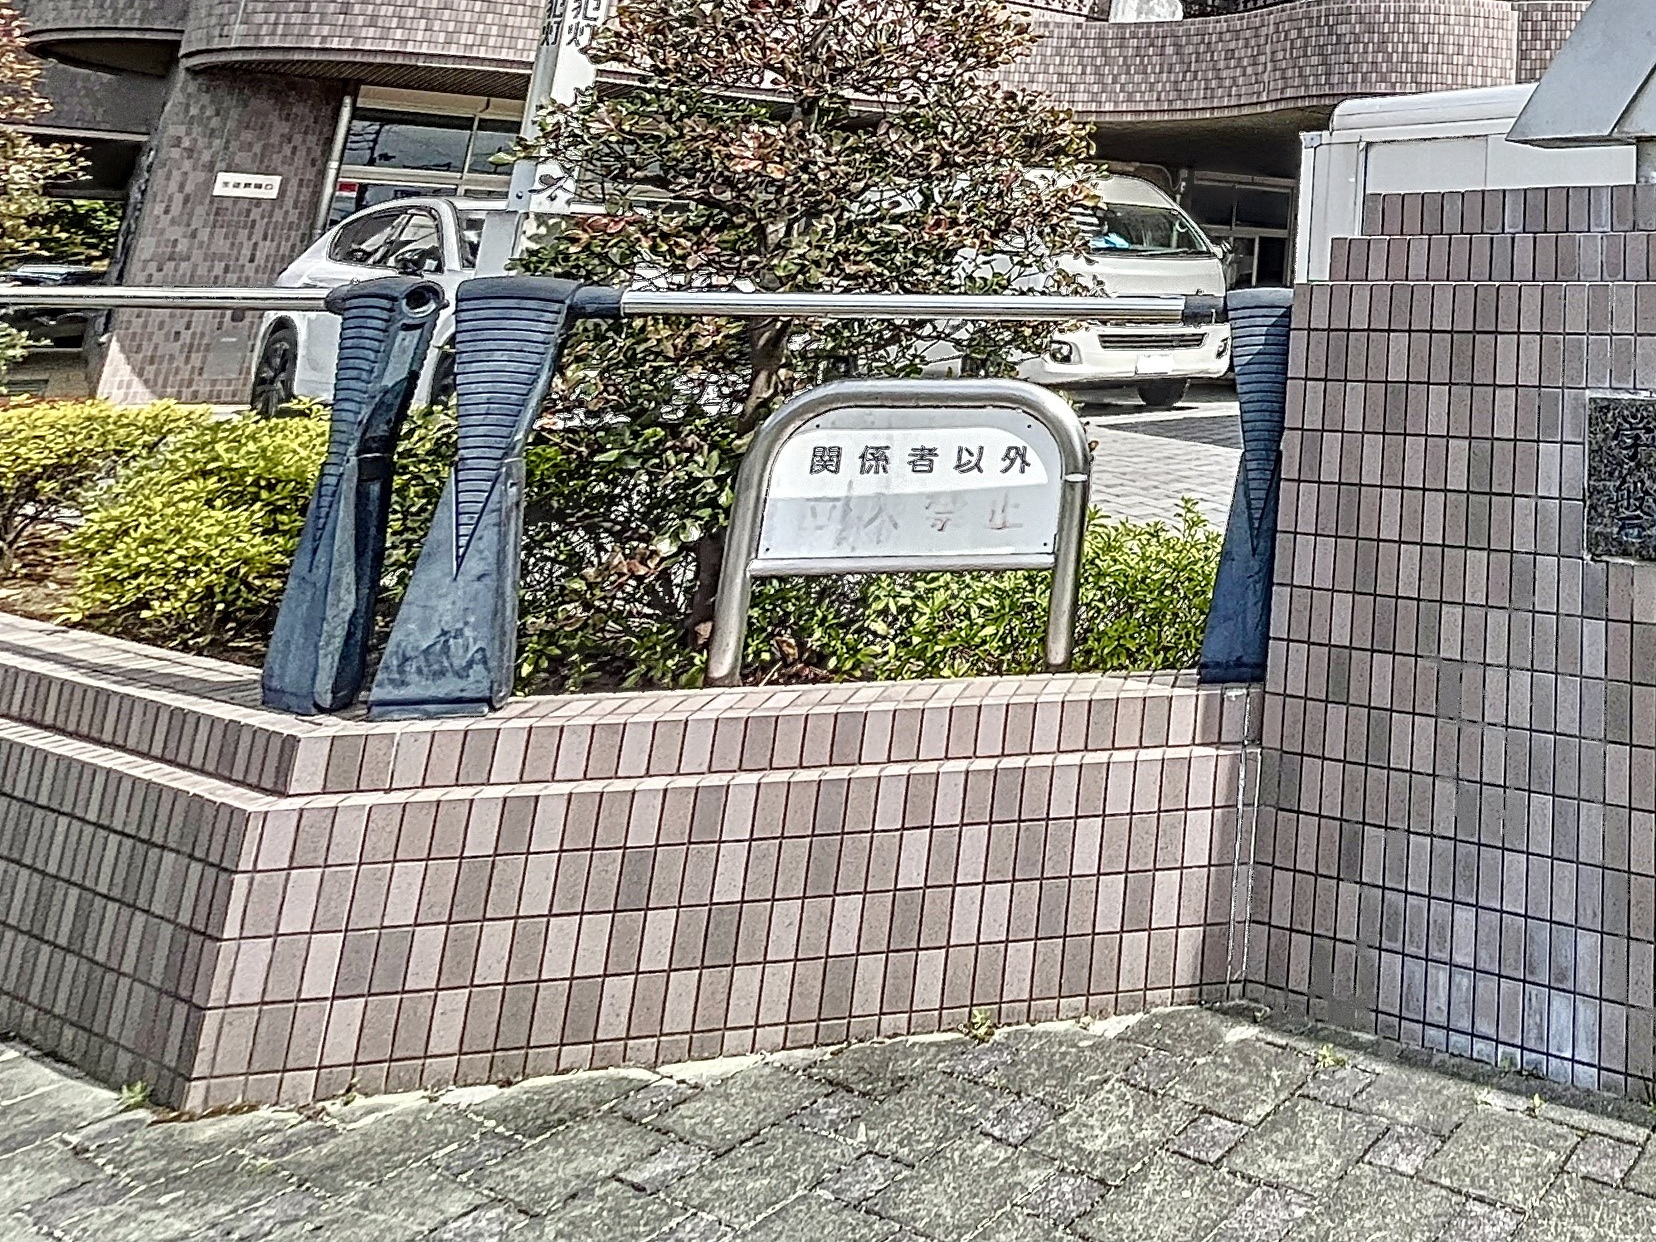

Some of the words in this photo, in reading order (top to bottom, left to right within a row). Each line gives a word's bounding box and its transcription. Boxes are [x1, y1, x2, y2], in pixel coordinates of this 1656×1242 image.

[808, 445, 1032, 476] 関係者以外
